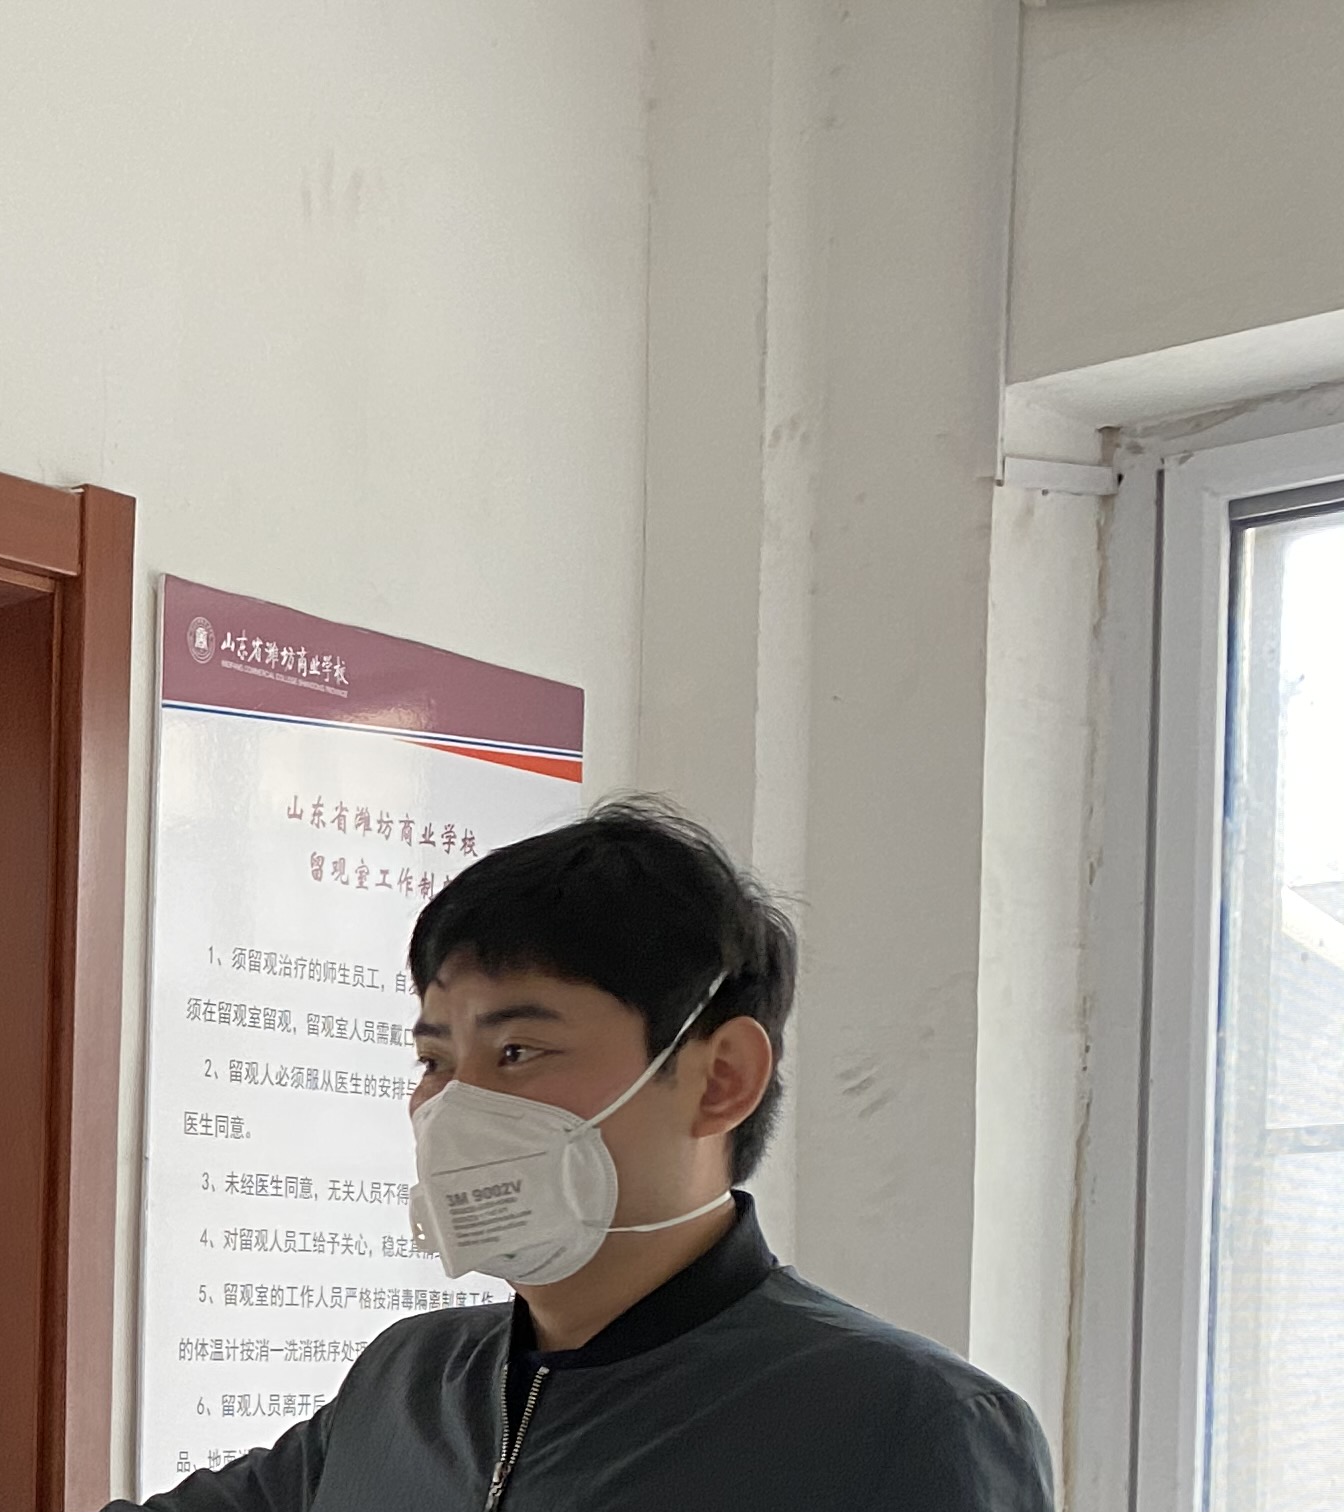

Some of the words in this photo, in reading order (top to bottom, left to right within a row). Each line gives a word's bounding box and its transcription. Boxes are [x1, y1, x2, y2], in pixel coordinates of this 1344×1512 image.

[220, 629, 350, 686] 山东省潍坊商业学校
[287, 795, 479, 857] 山东省潍坊商业学校
[183, 1111, 253, 1140] 医生同意。
[176, 1449, 250, 1473] 品、地
